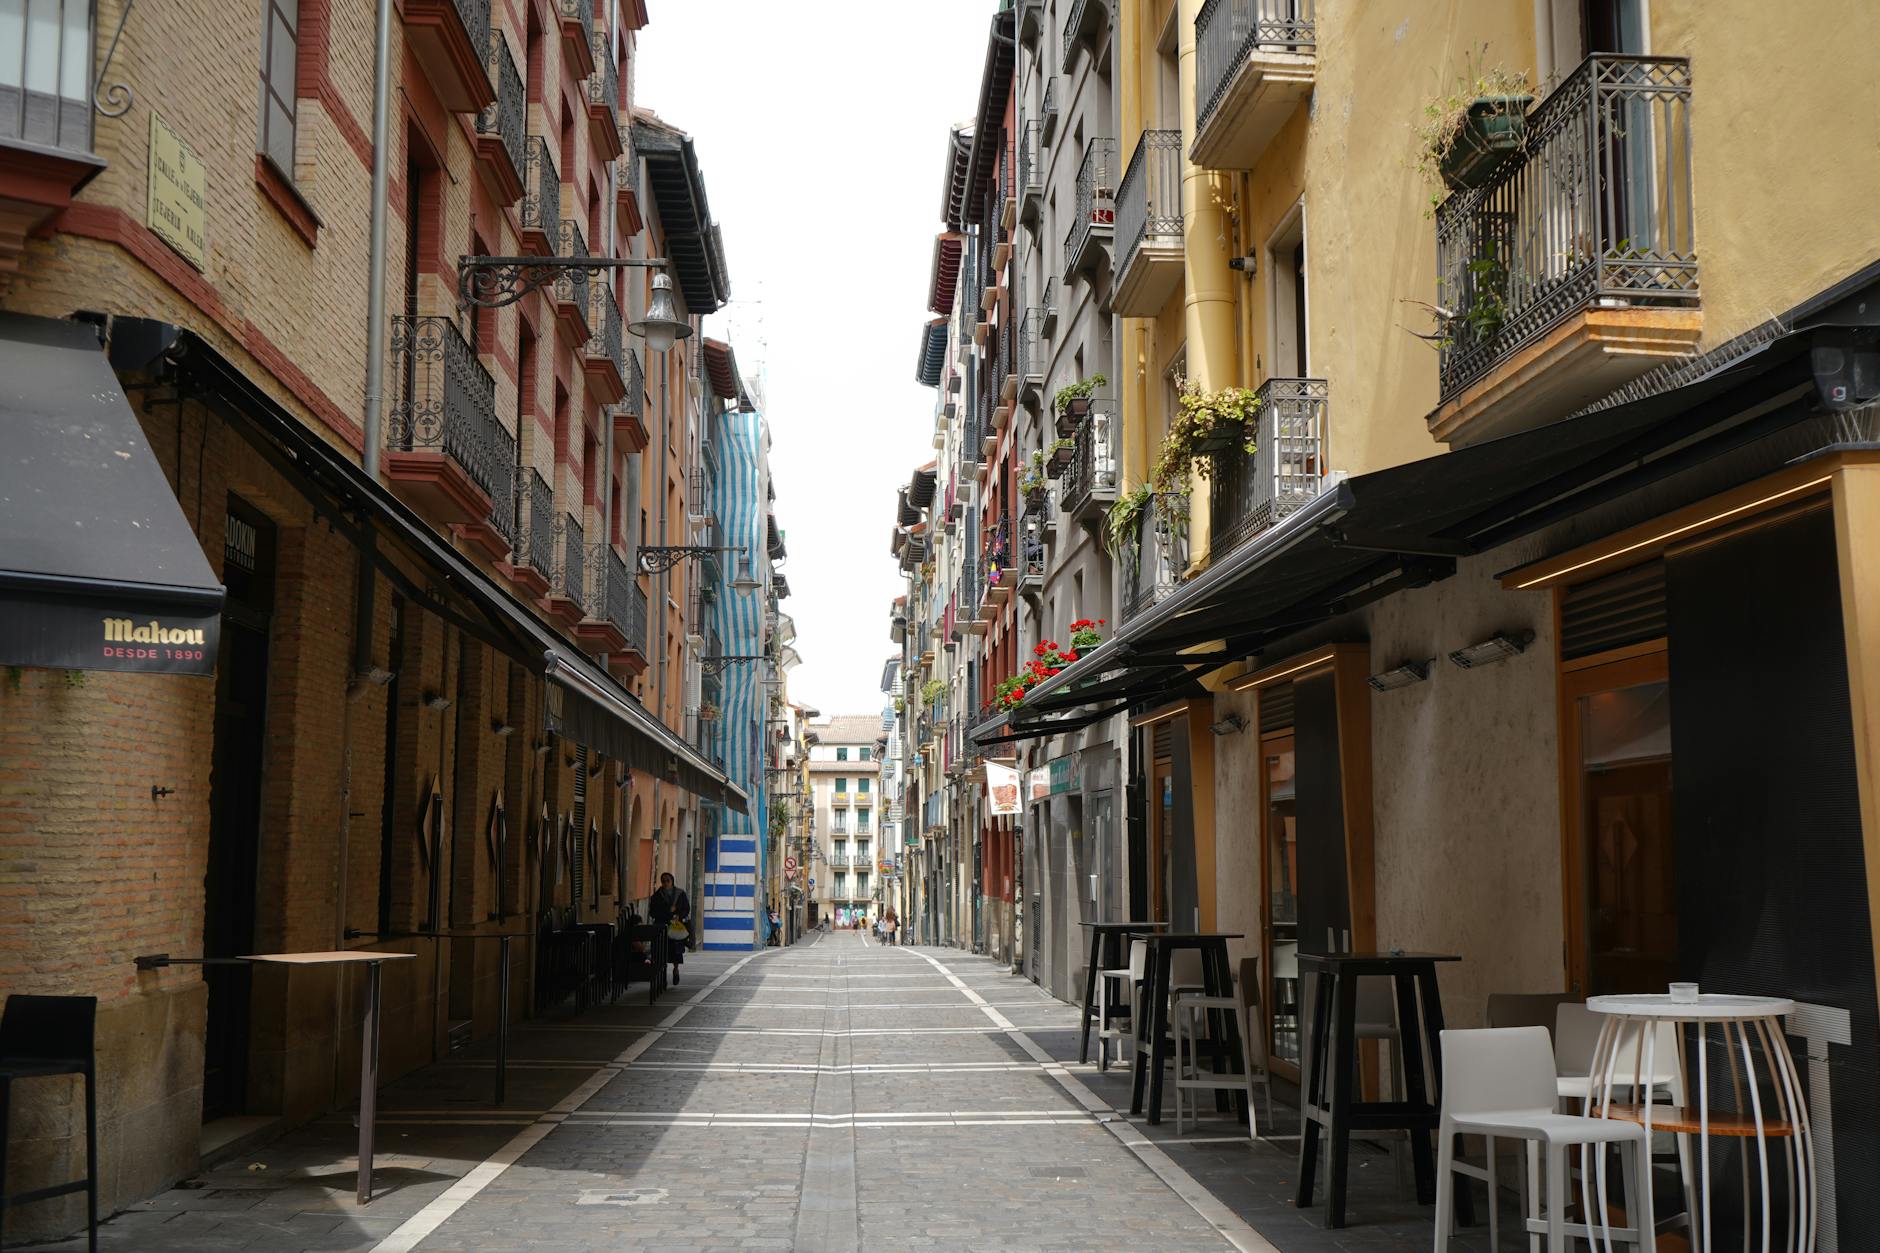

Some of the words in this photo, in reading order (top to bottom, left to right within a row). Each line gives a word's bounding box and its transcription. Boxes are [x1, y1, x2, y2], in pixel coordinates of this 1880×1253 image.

[157, 156, 175, 185] CALLE
[103, 617, 205, 645] Mahou
[103, 647, 158, 659] DESDE
[165, 649, 203, 661] 1890
